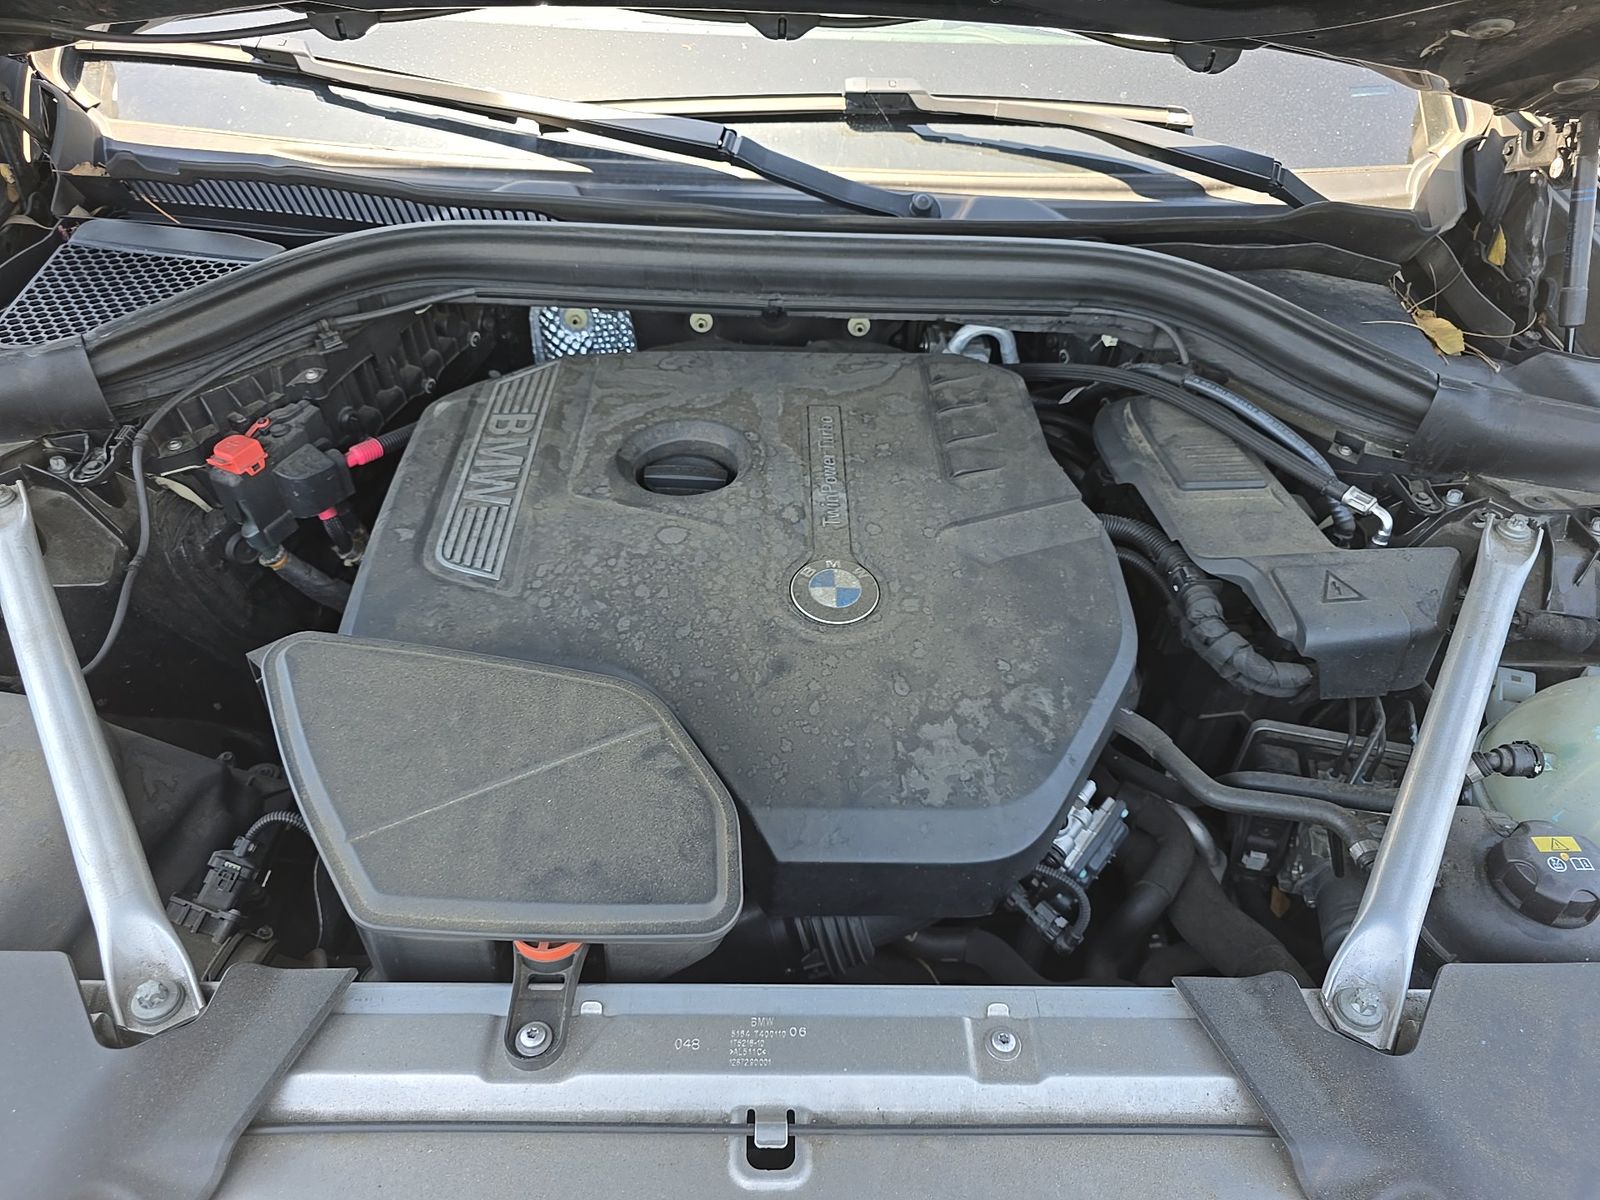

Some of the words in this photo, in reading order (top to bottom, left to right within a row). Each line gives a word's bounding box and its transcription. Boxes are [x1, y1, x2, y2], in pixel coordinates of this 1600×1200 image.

[818, 415, 834, 449] Turbo
[462, 413, 537, 506] BMW
[821, 452, 841, 527] TwinPower
[800, 559, 870, 579] BMW
[750, 1016, 775, 1028] BMW
[789, 1026, 807, 1038] 06
[674, 1038, 701, 1051] 048
